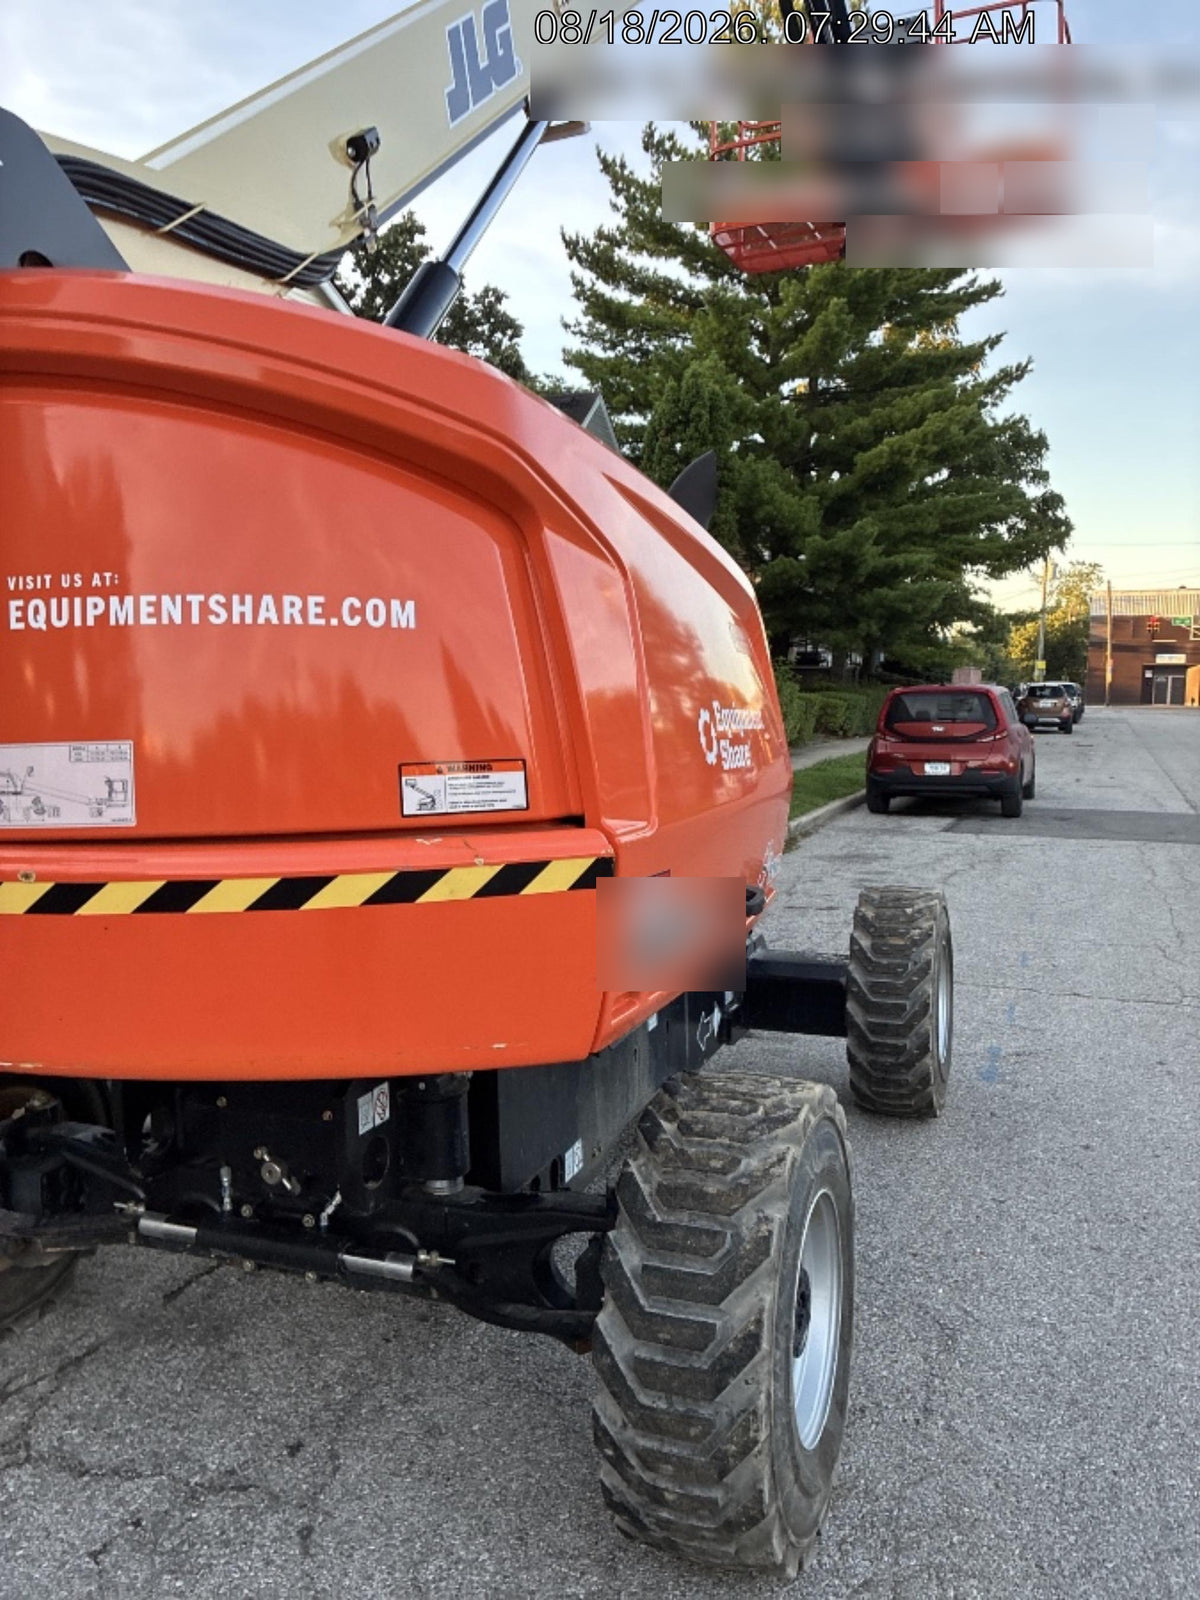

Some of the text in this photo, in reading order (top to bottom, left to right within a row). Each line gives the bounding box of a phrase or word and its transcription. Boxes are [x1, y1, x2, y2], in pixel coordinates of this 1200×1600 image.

[444, 0, 518, 129] JLG
[7, 572, 119, 591] VISIT US AT:
[8, 593, 416, 632] EQUIPMENTSHARE.COM
[719, 738, 752, 771] Share
